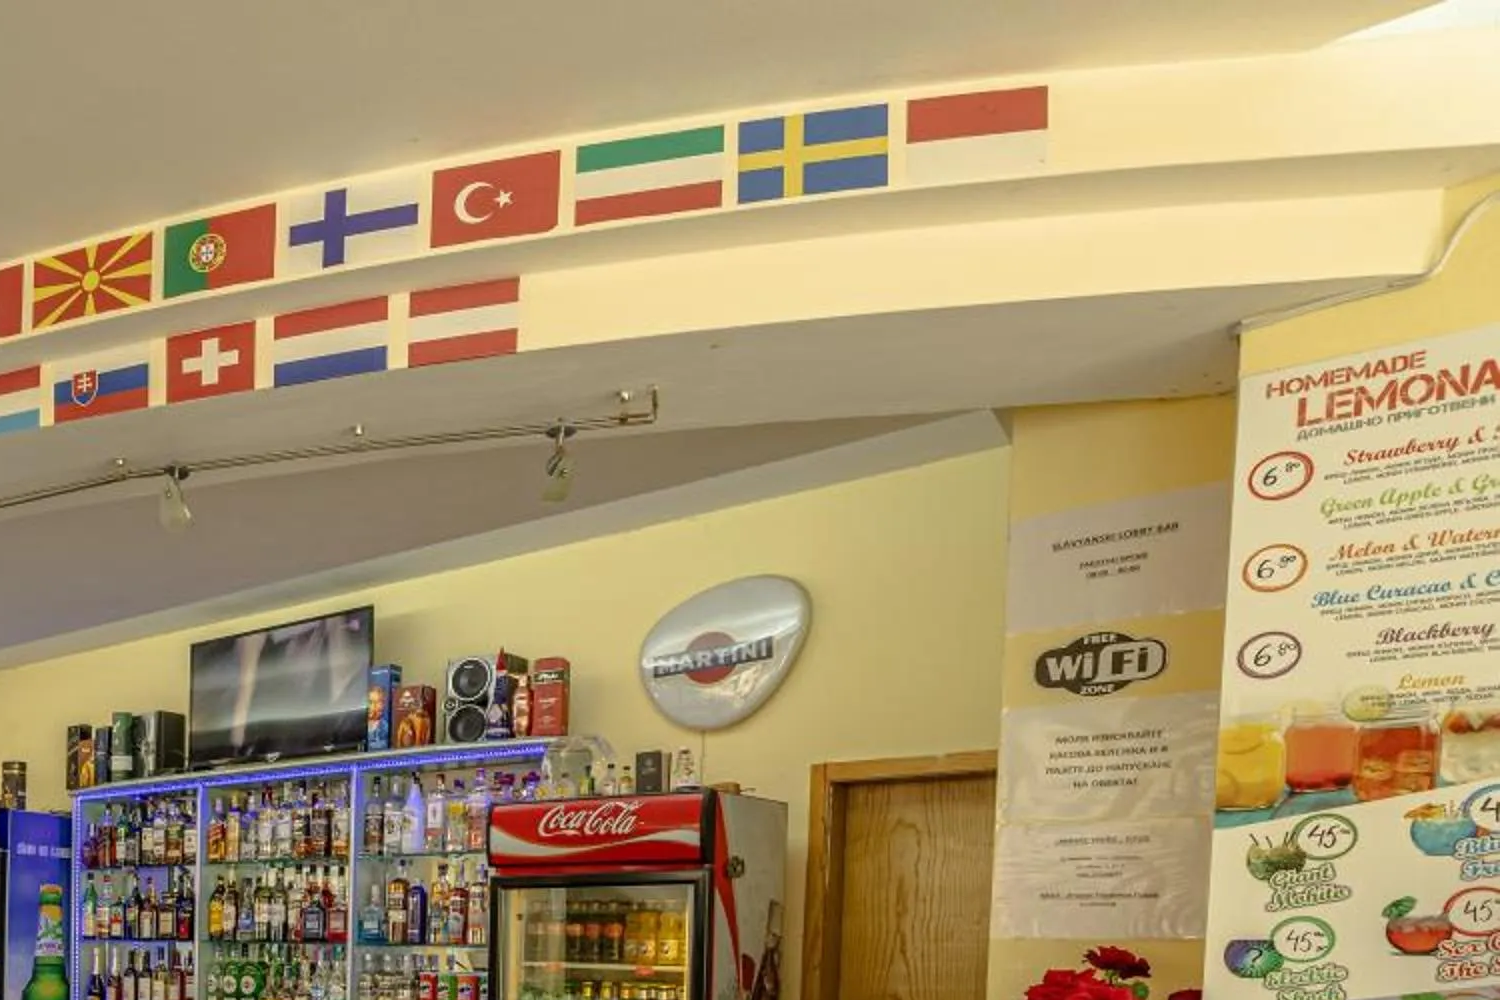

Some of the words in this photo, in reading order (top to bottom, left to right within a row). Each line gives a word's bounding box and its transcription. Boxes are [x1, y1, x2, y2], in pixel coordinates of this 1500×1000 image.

[1265, 350, 1427, 399] HOMEMADE
[1296, 358, 1500, 428] LEMONA
[1296, 414, 1383, 442] ДОМАШНО
[1343, 437, 1459, 467] Strawberry
[1320, 497, 1374, 518] Green
[1379, 483, 1441, 508] Apple
[1328, 541, 1395, 561] Melon
[1311, 590, 1360, 609] Blue
[1366, 581, 1452, 601] Curacao
[1083, 632, 1118, 645] FREE
[1375, 621, 1495, 645] Blackberry
[1396, 674, 1467, 691] Lemon
